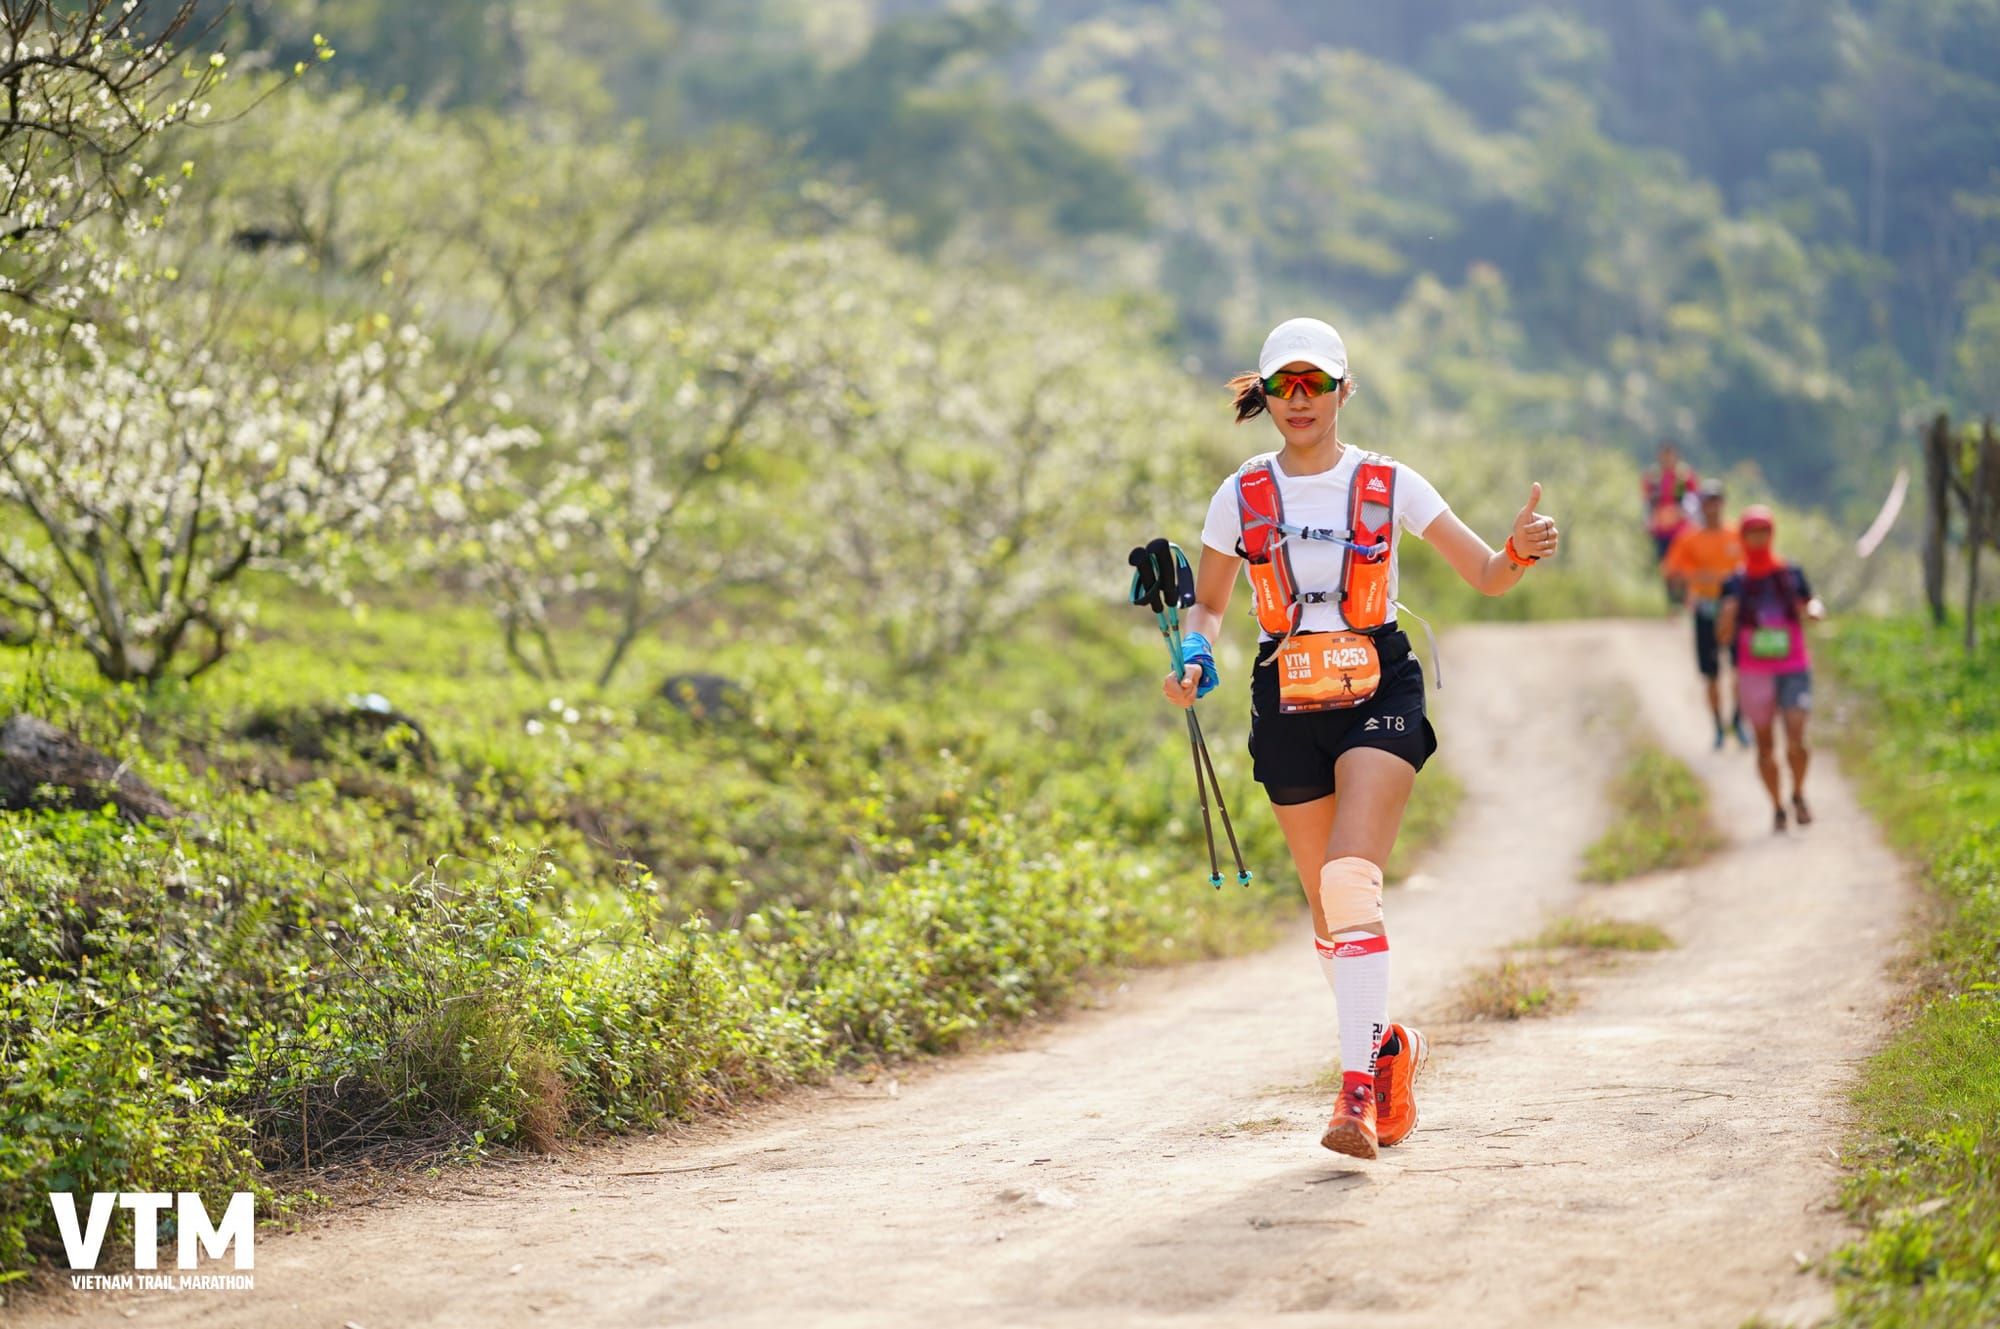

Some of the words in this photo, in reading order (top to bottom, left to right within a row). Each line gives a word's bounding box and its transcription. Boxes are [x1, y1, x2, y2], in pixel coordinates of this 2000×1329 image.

[1284, 652, 1311, 667] VTM
[1323, 647, 1369, 669] F4253
[1287, 670, 1298, 680] 42
[1382, 716, 1405, 731] T8
